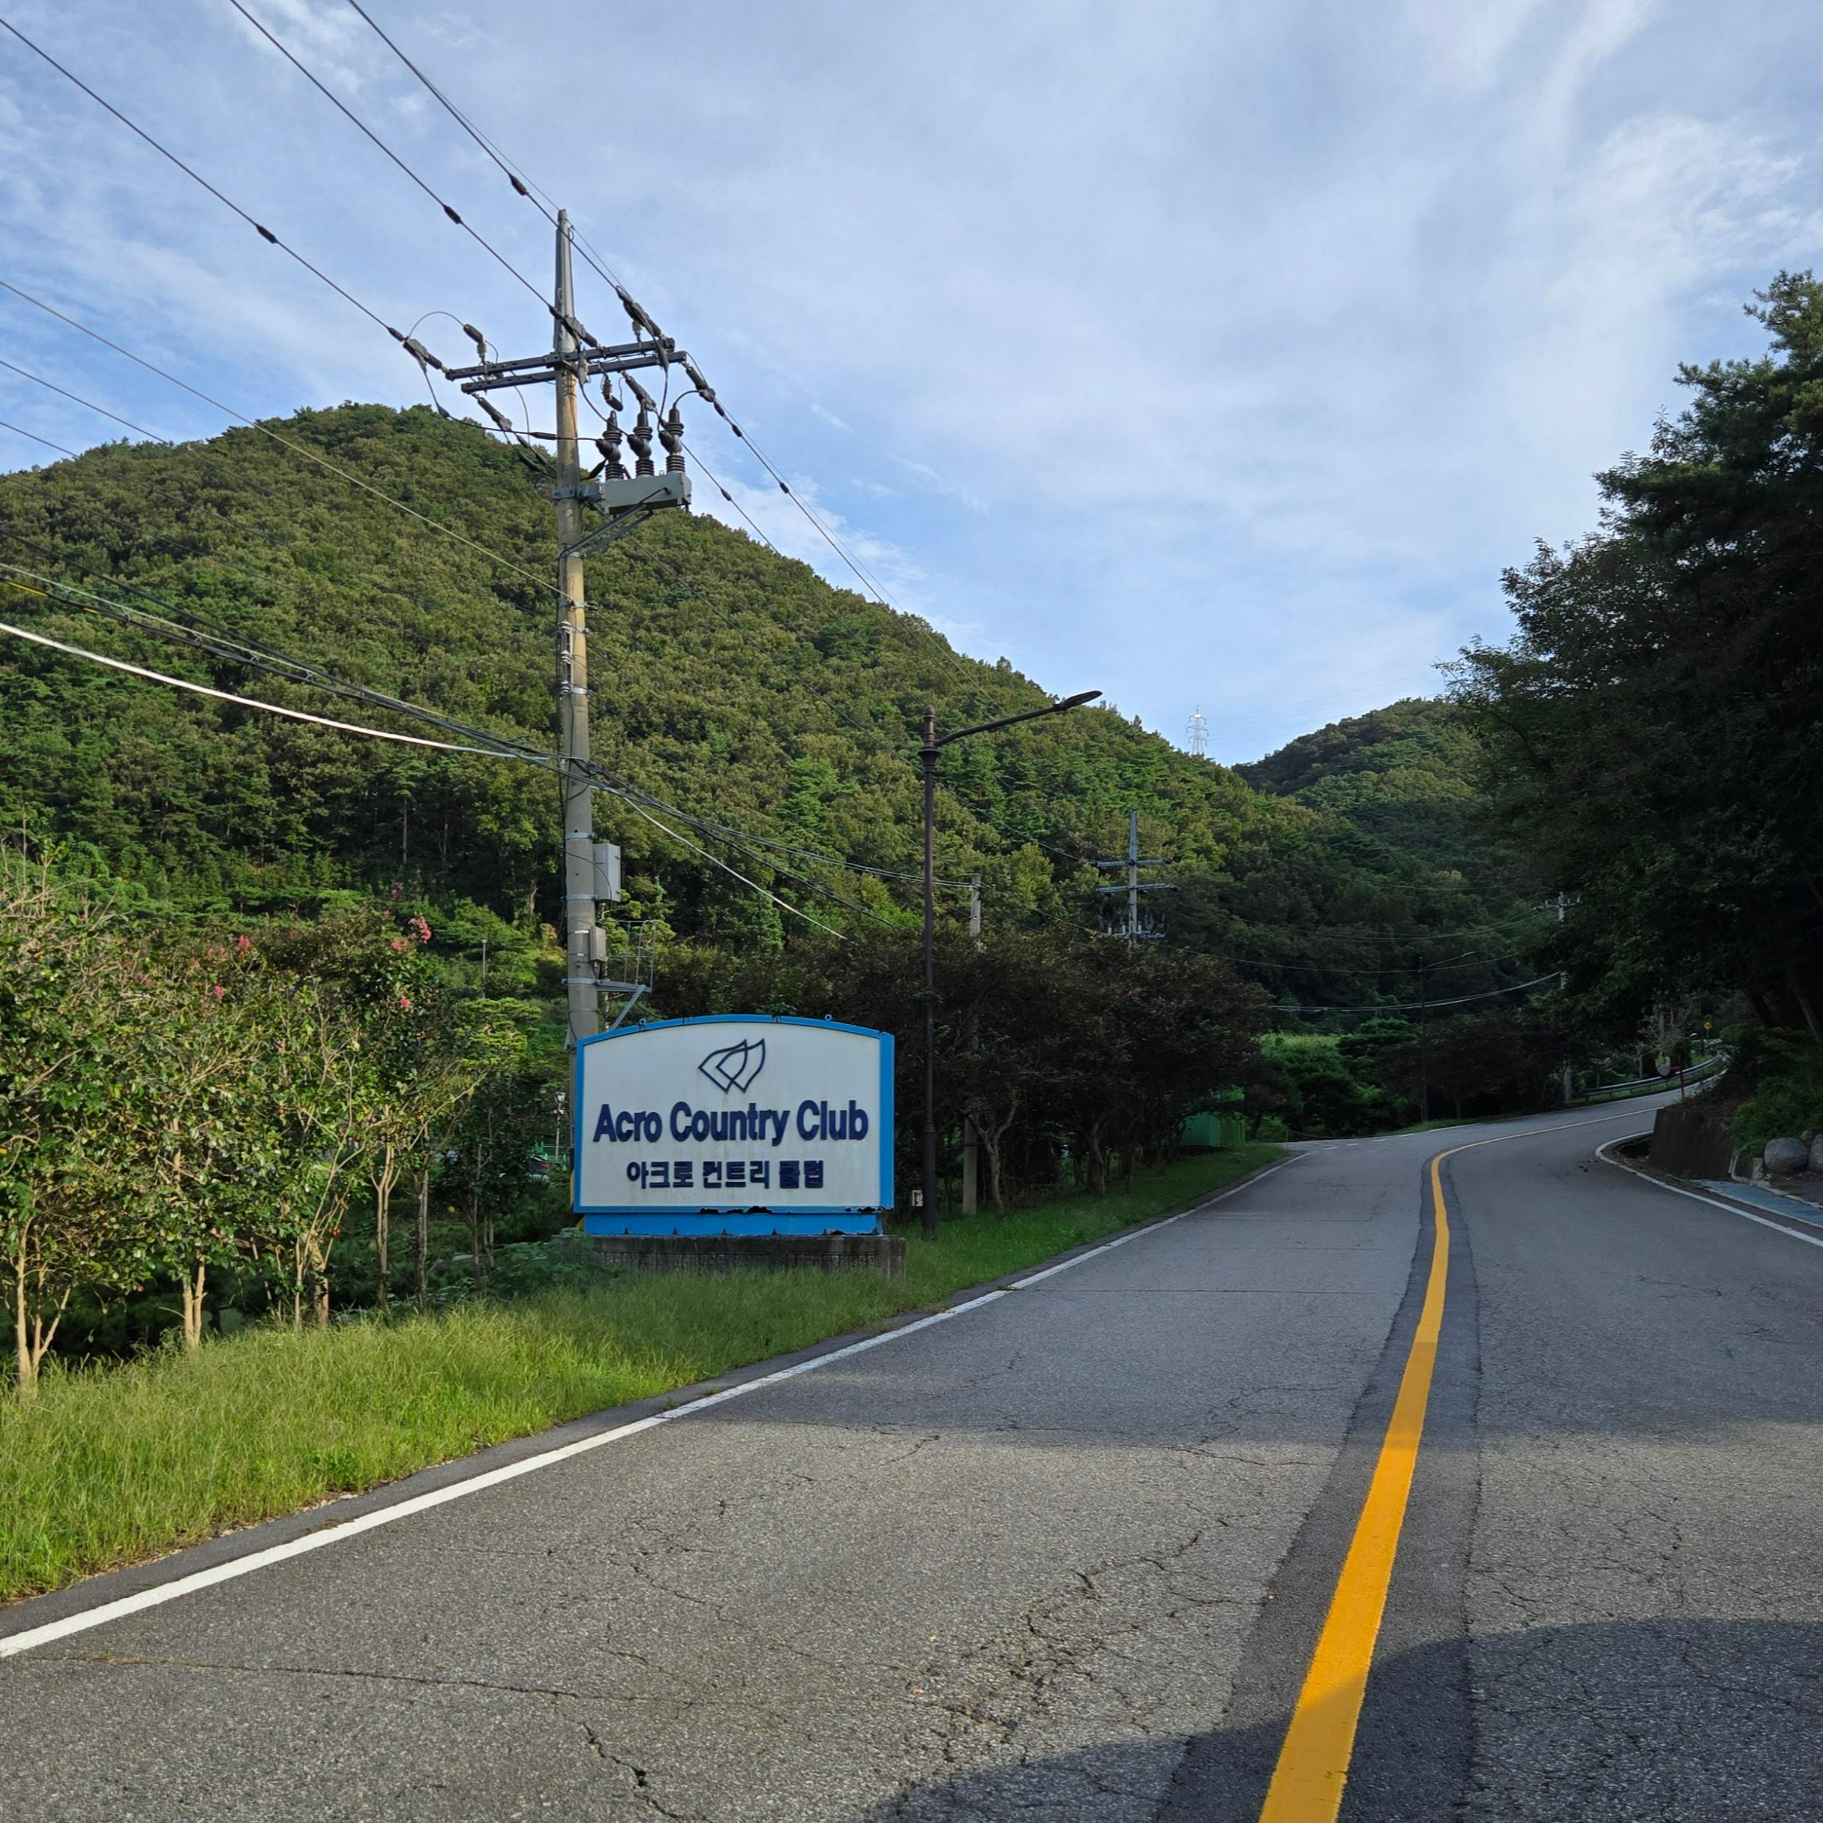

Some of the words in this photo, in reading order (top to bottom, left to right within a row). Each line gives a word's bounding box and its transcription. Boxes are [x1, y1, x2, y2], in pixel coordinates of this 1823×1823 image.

[593, 1103, 663, 1142] Acro
[669, 1101, 790, 1147] Country
[796, 1099, 869, 1141] Club
[626, 1160, 694, 1190] 아크로
[702, 1160, 770, 1190] 컨트리
